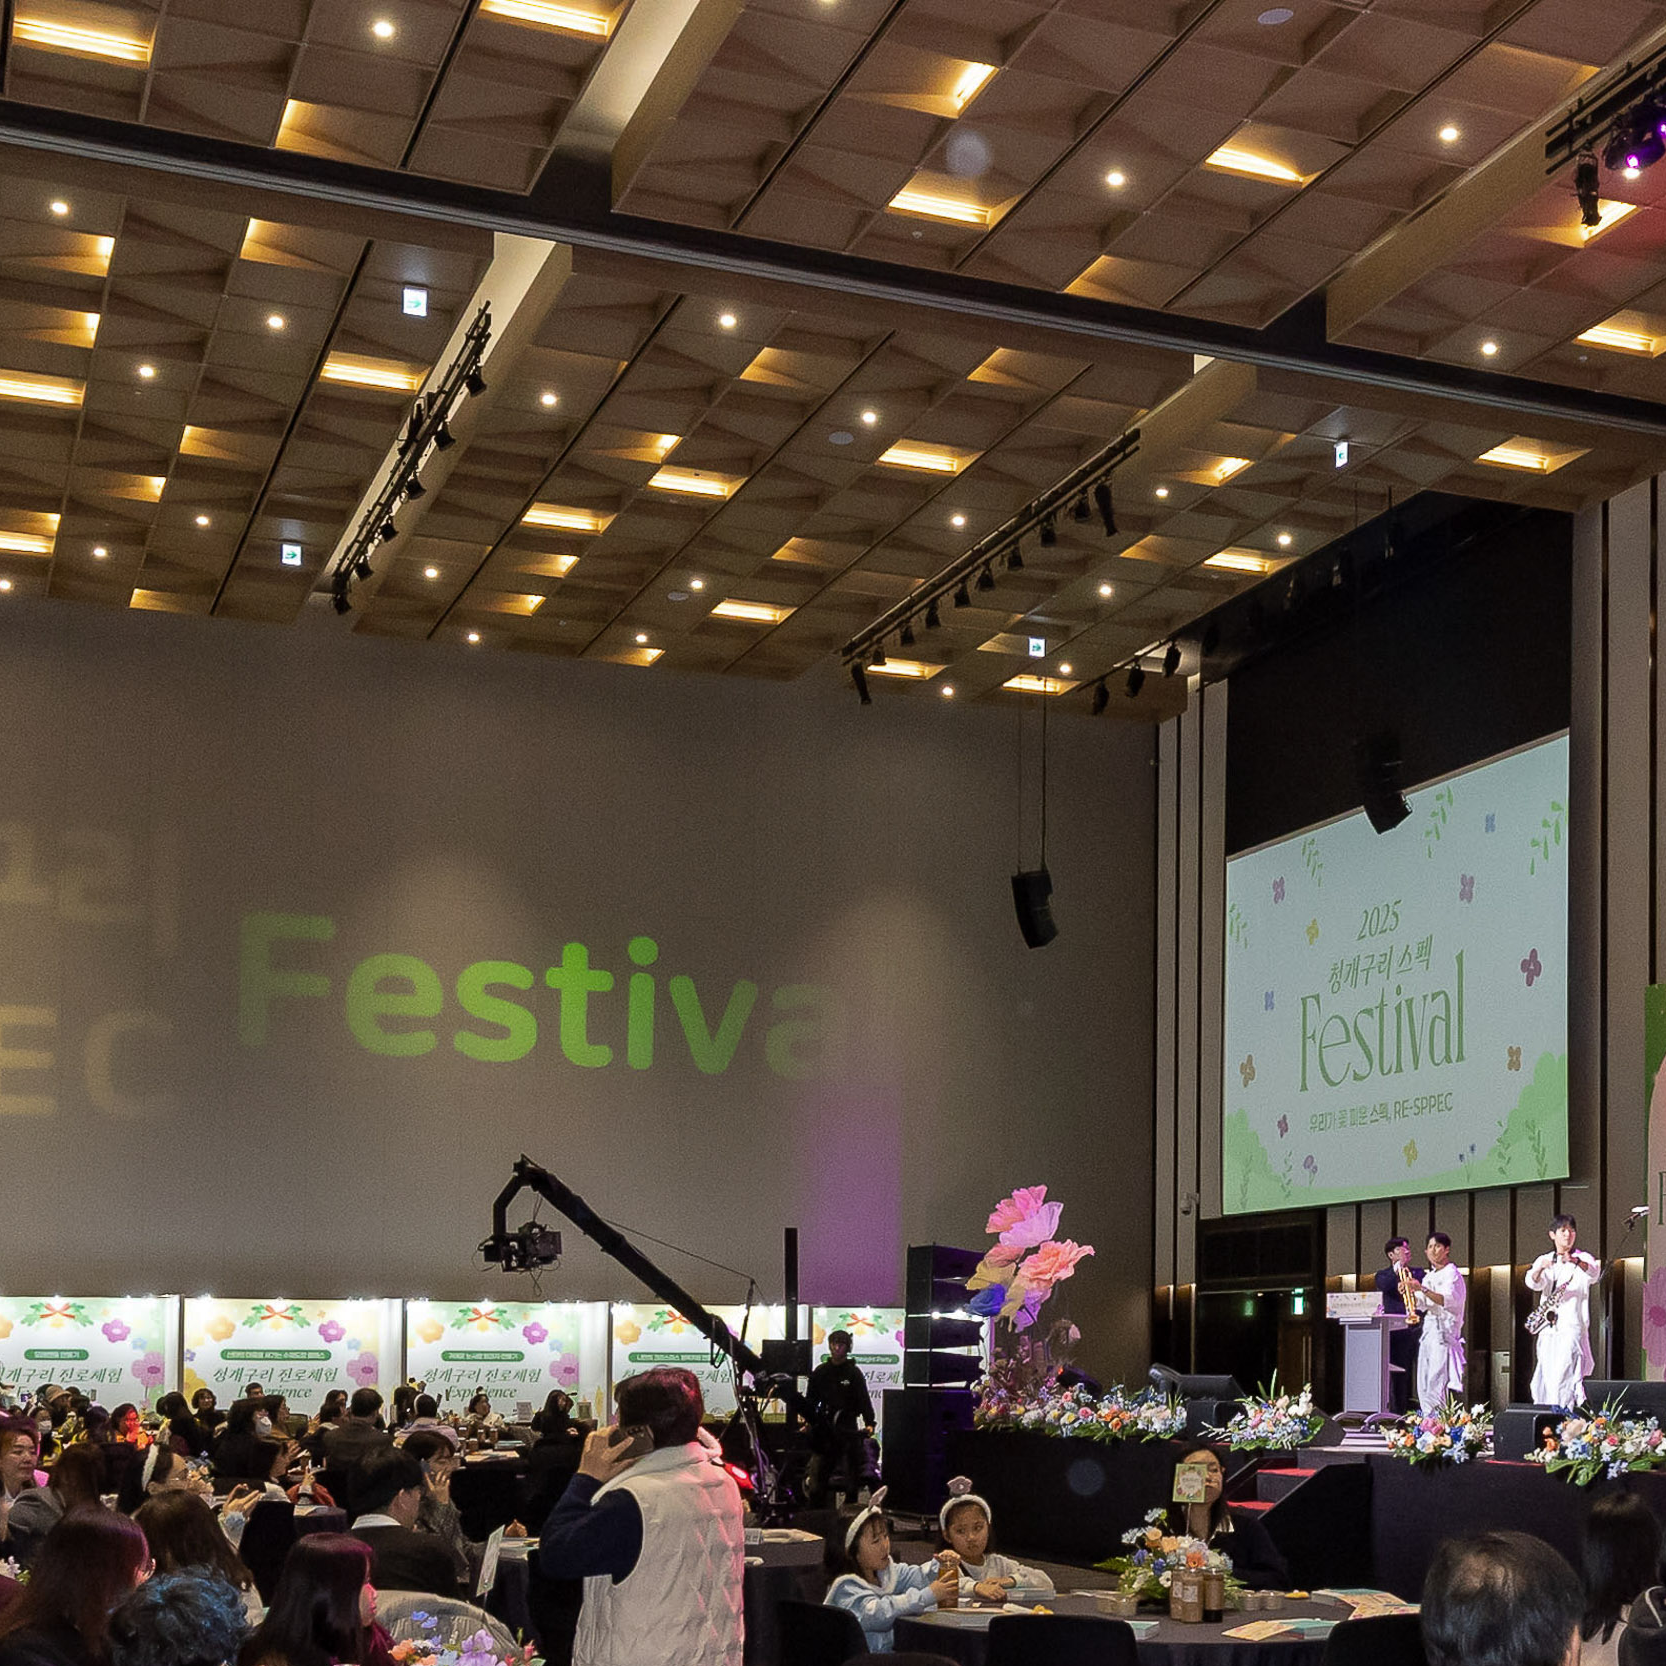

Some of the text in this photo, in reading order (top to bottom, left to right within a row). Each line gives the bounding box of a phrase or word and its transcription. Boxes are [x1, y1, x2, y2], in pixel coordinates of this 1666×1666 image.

[1355, 899, 1402, 941] 2025
[1328, 934, 1433, 994] 청개구리 스펙
[239, 910, 865, 1080] Festiva
[1299, 949, 1466, 1092] Festival
[1393, 1092, 1454, 1119] RE-SPPEC
